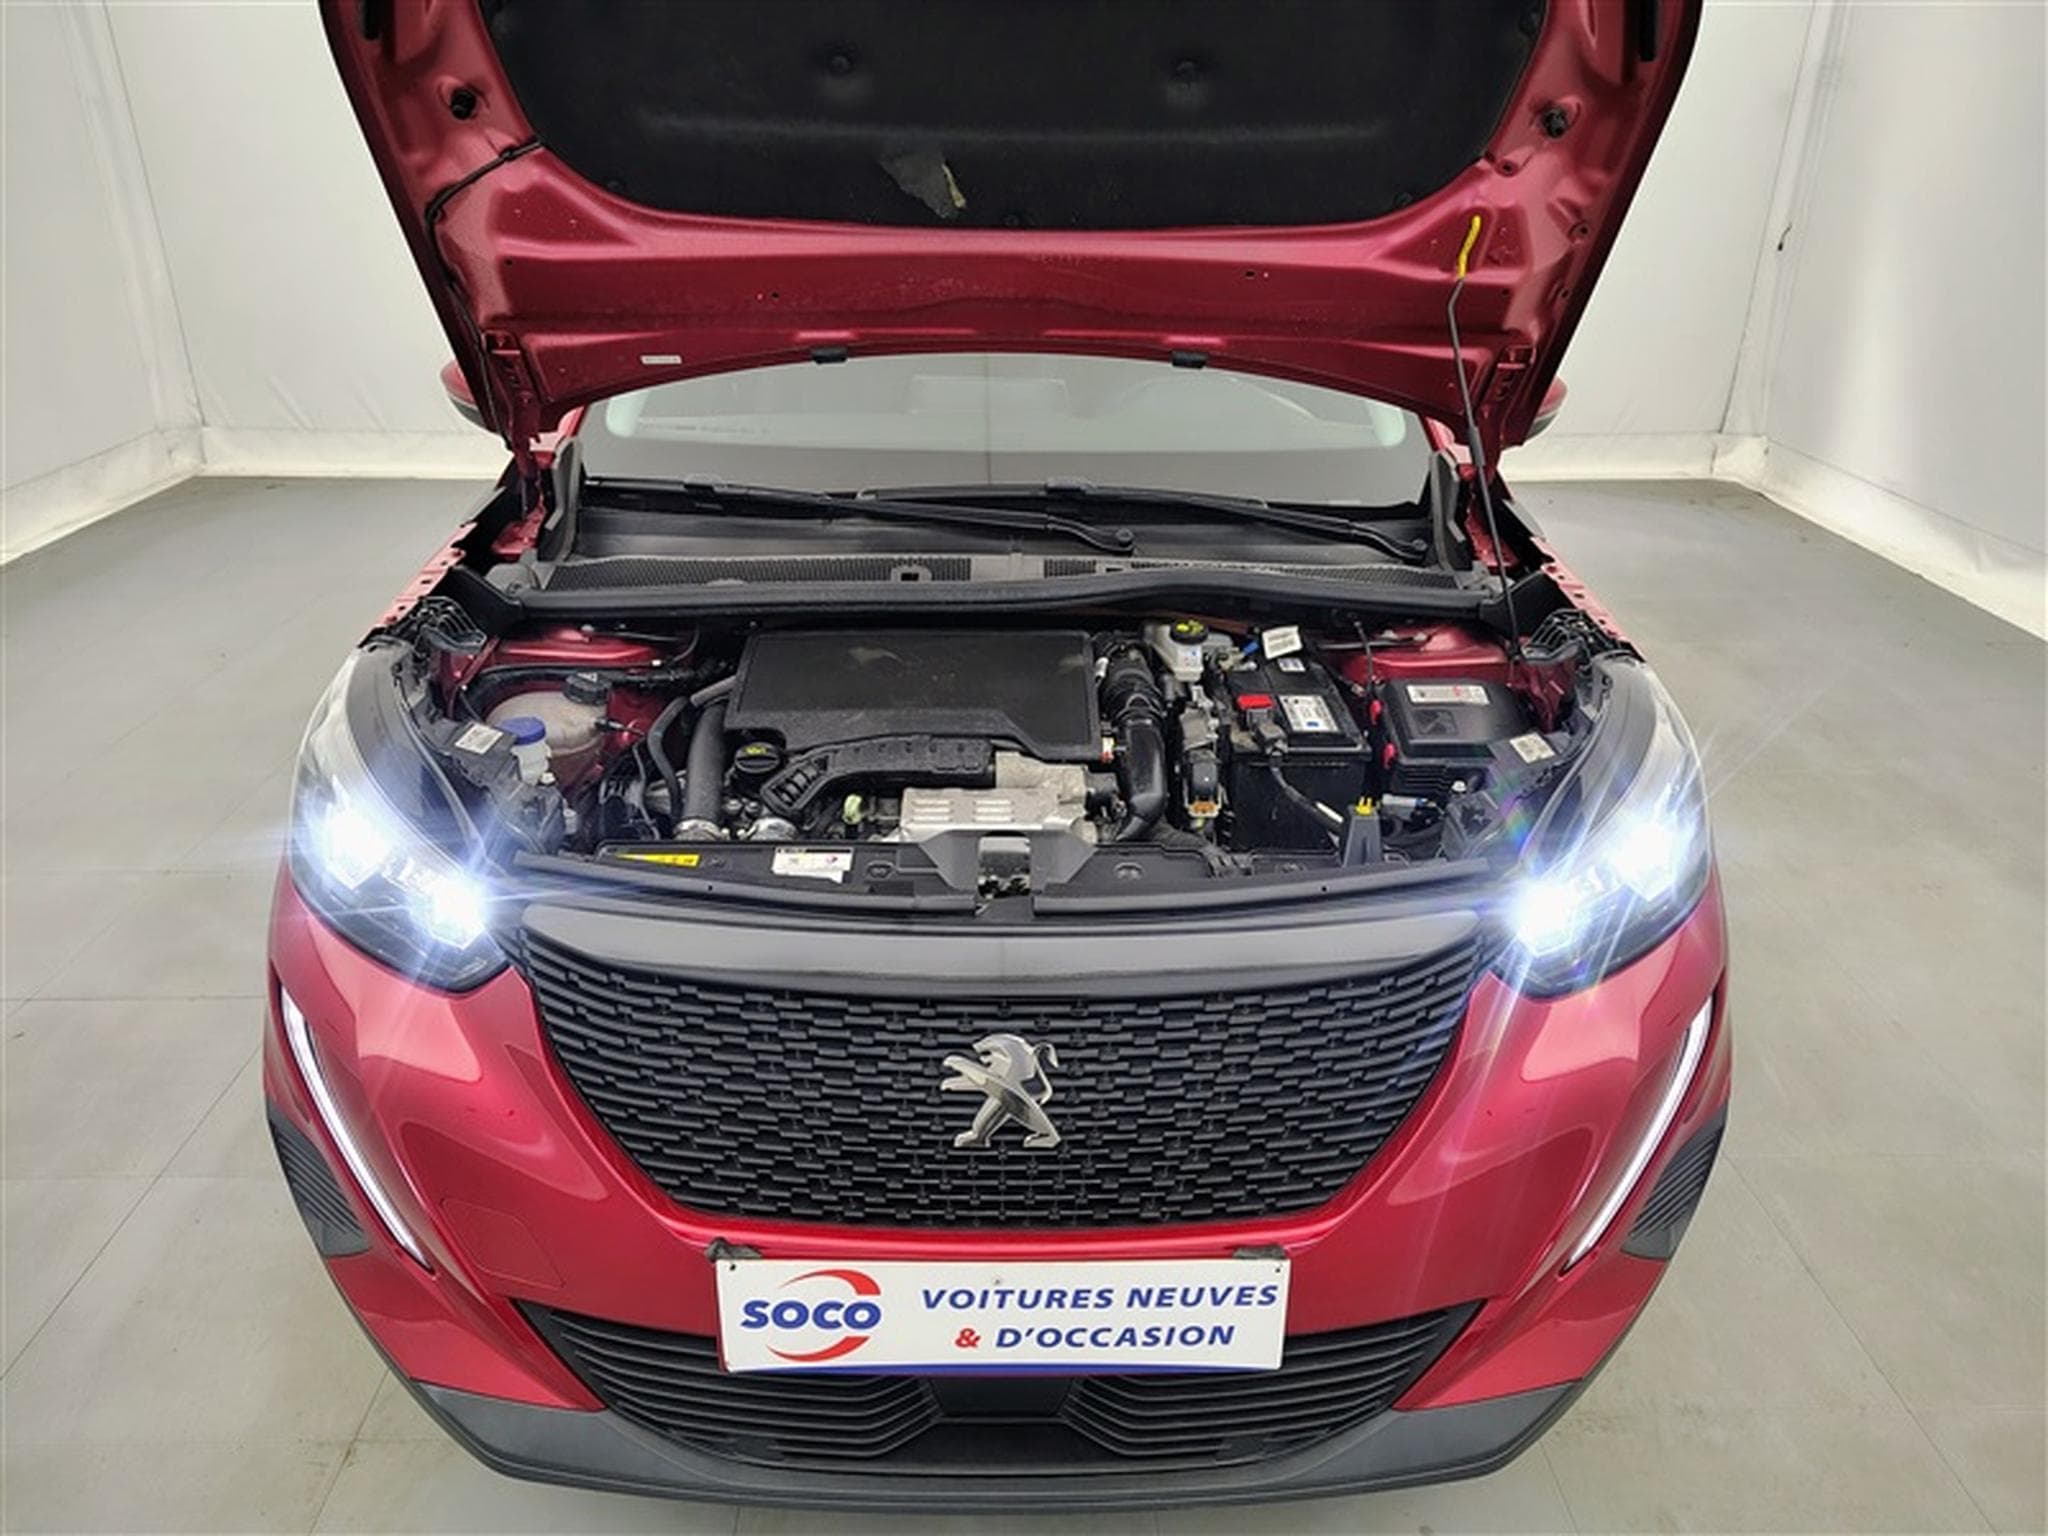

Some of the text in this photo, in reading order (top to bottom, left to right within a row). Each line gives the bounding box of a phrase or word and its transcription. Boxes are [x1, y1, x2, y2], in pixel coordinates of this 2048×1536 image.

[922, 1285, 1278, 1310] VOITURES NEUVES
[741, 1300, 881, 1330] SOCO
[955, 1325, 1235, 1348] & D'OCCASION
